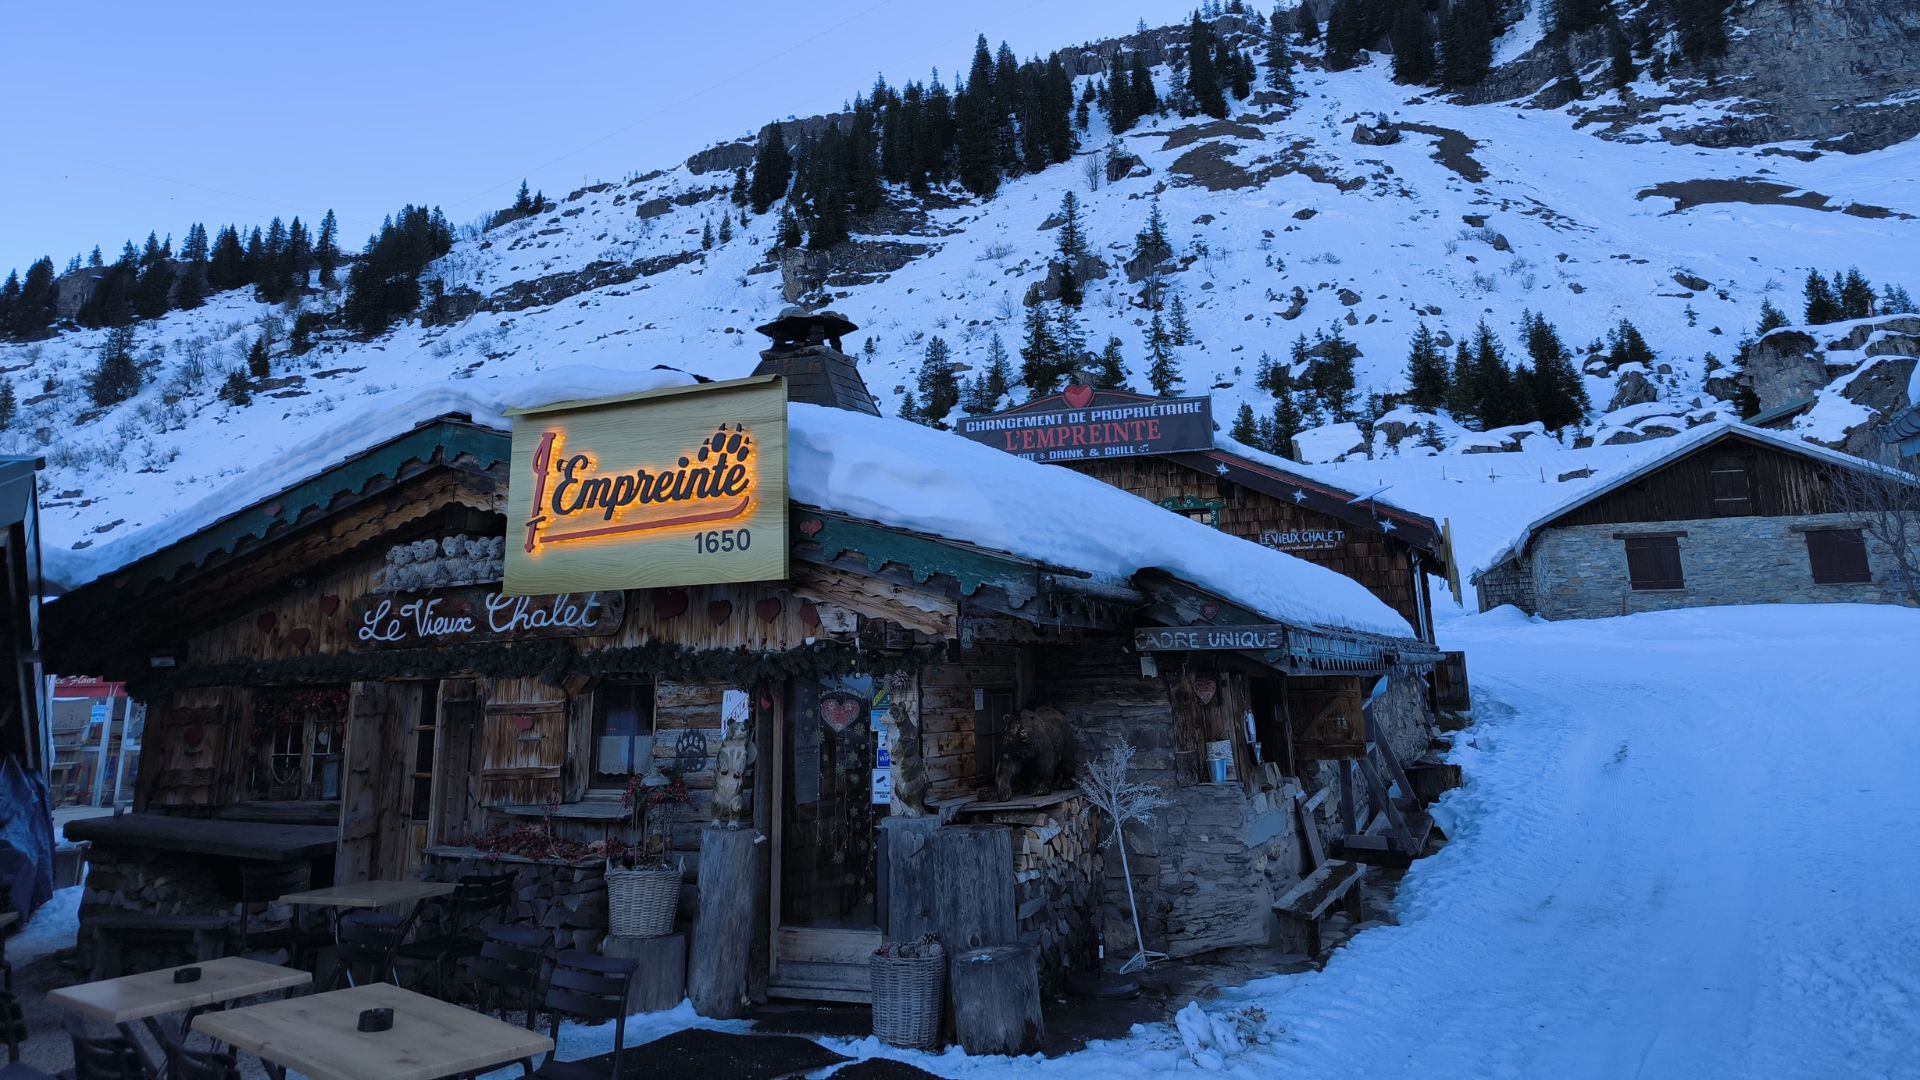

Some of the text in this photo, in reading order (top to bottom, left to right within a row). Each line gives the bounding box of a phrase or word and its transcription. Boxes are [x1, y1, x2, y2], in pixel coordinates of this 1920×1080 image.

[966, 401, 1203, 433] CHANGEMENT DE PROPRIÉTAIRE
[1005, 420, 1162, 452] L'EMPREINTE
[1049, 448, 1085, 460] DRINK
[1089, 448, 1100, 457] &
[1104, 445, 1136, 456] CHILL
[694, 528, 751, 554] 1650
[1259, 533, 1271, 545] LE
[1302, 530, 1343, 543] CHALET
[358, 591, 601, 641] Le Vieux Chalet
[1135, 632, 1200, 649] CADRE
